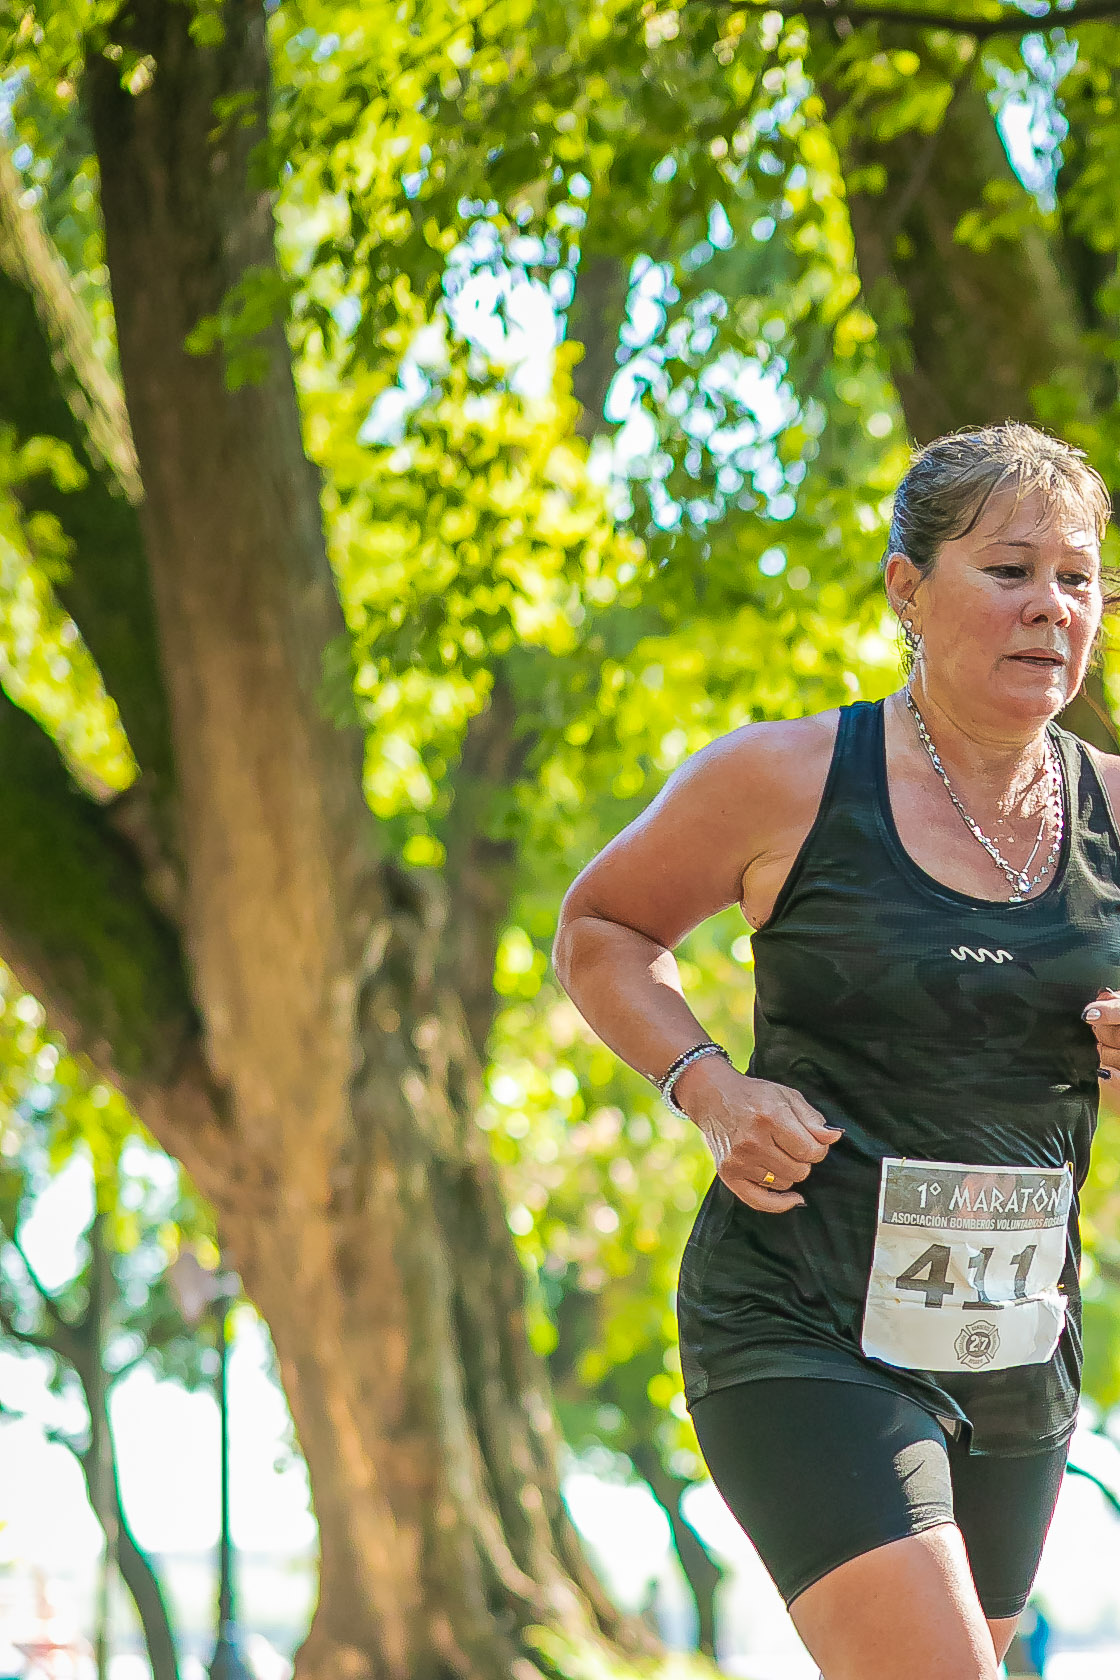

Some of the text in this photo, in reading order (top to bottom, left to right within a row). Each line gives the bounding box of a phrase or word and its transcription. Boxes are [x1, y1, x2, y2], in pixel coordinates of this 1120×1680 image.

[949, 1180, 1061, 1214] MARATÓN
[891, 1212, 947, 1228] ASOCIACIÓN
[950, 1217, 994, 1230] BOMBEROS
[996, 1218, 1043, 1230] VOLUNTARIOS
[896, 1244, 1044, 1310] 411
[969, 1334, 989, 1352] 27
